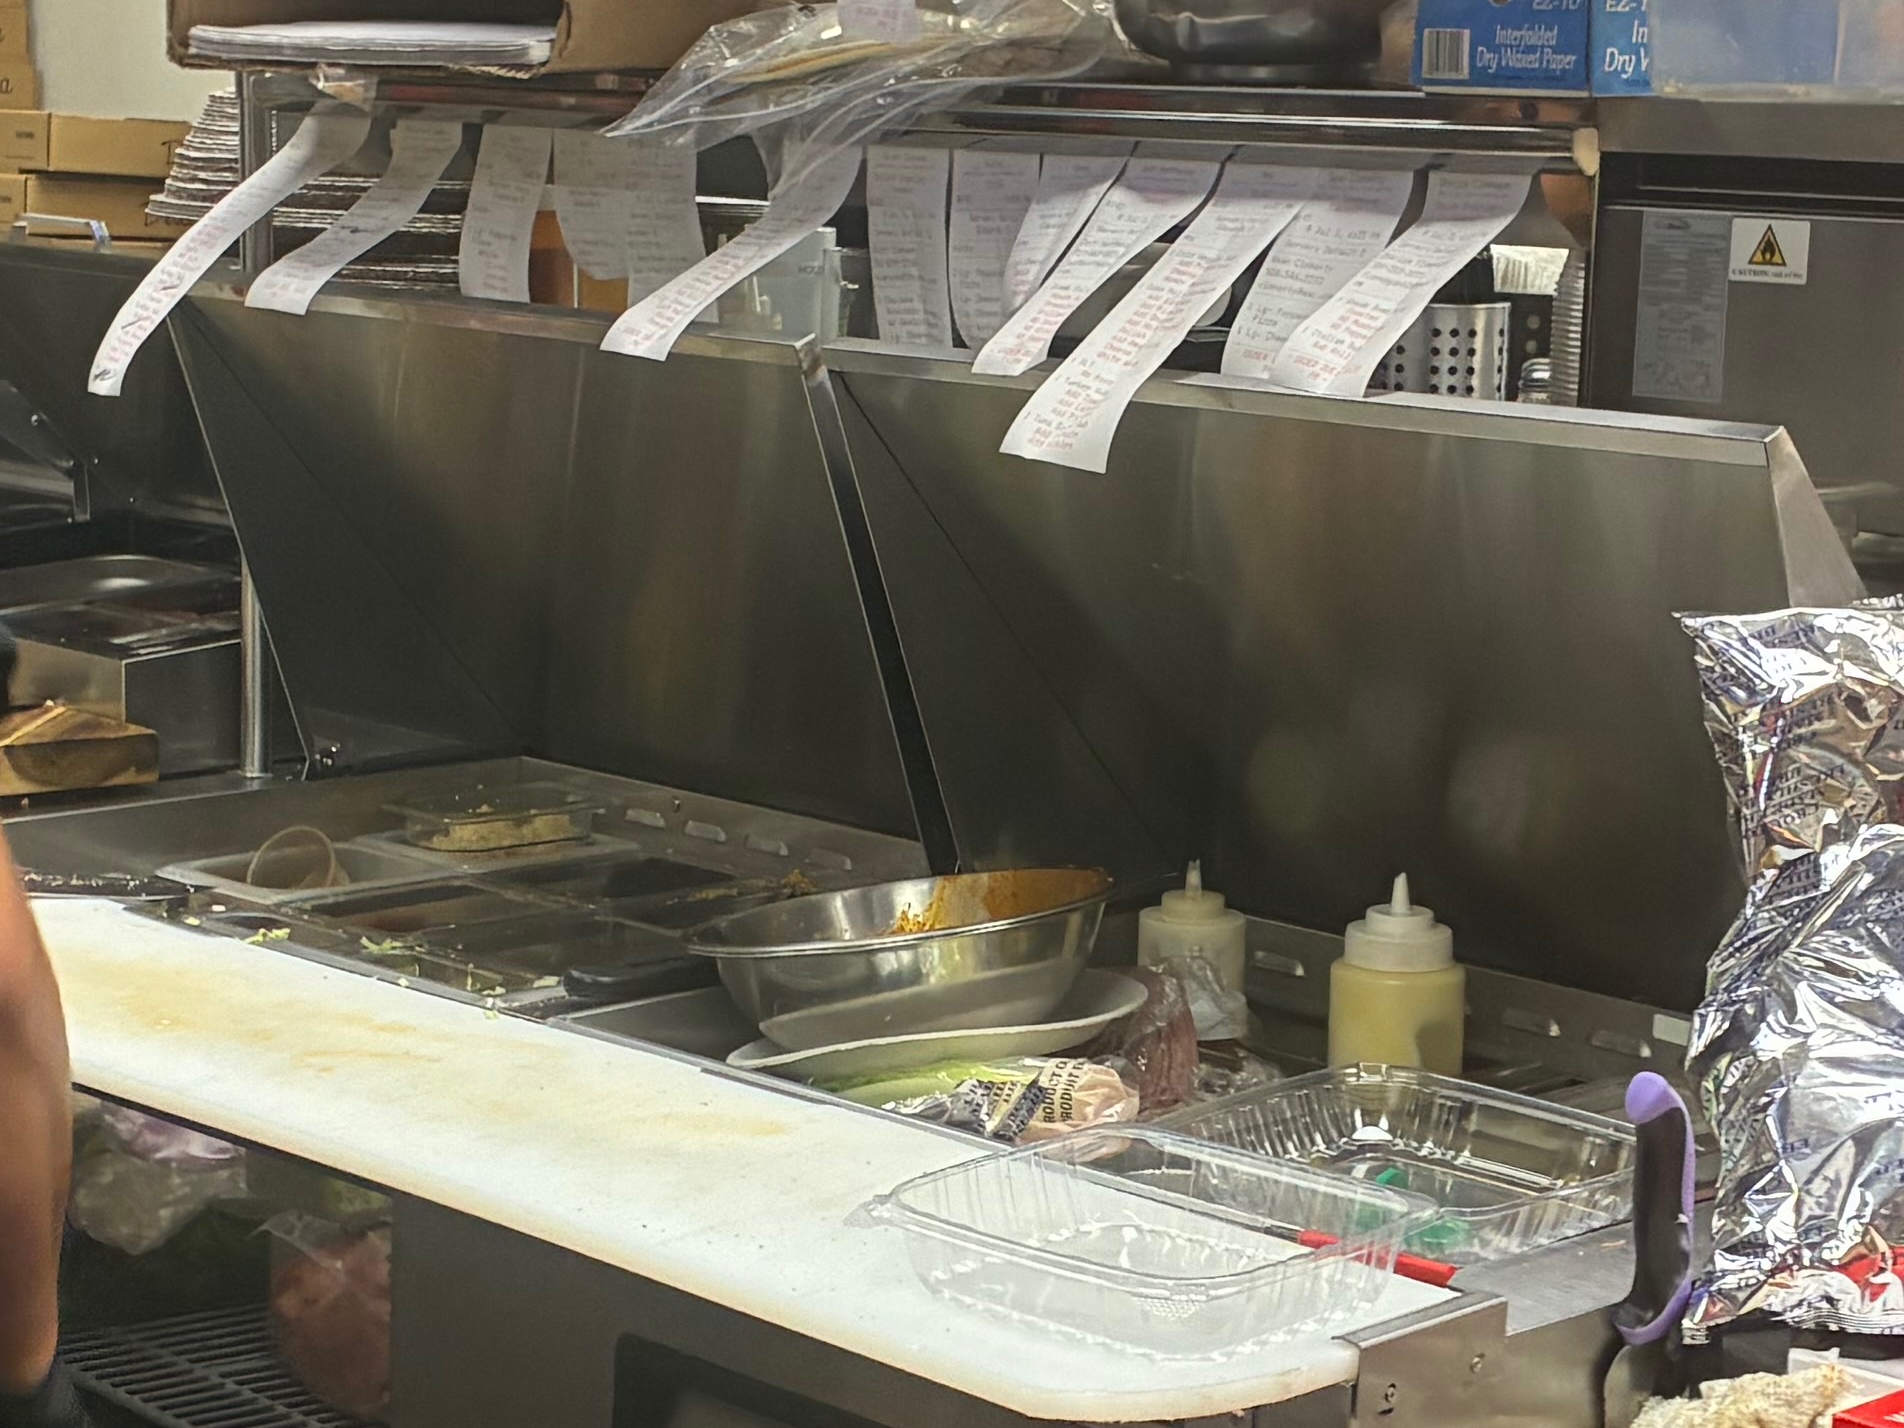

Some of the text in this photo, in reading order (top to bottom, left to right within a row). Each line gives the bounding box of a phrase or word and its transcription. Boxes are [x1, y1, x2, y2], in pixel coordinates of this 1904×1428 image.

[1495, 24, 1559, 47] Interfolded
[1476, 46, 1578, 75] Dry Waxed Paper
[1604, 47, 1636, 79] Dry
